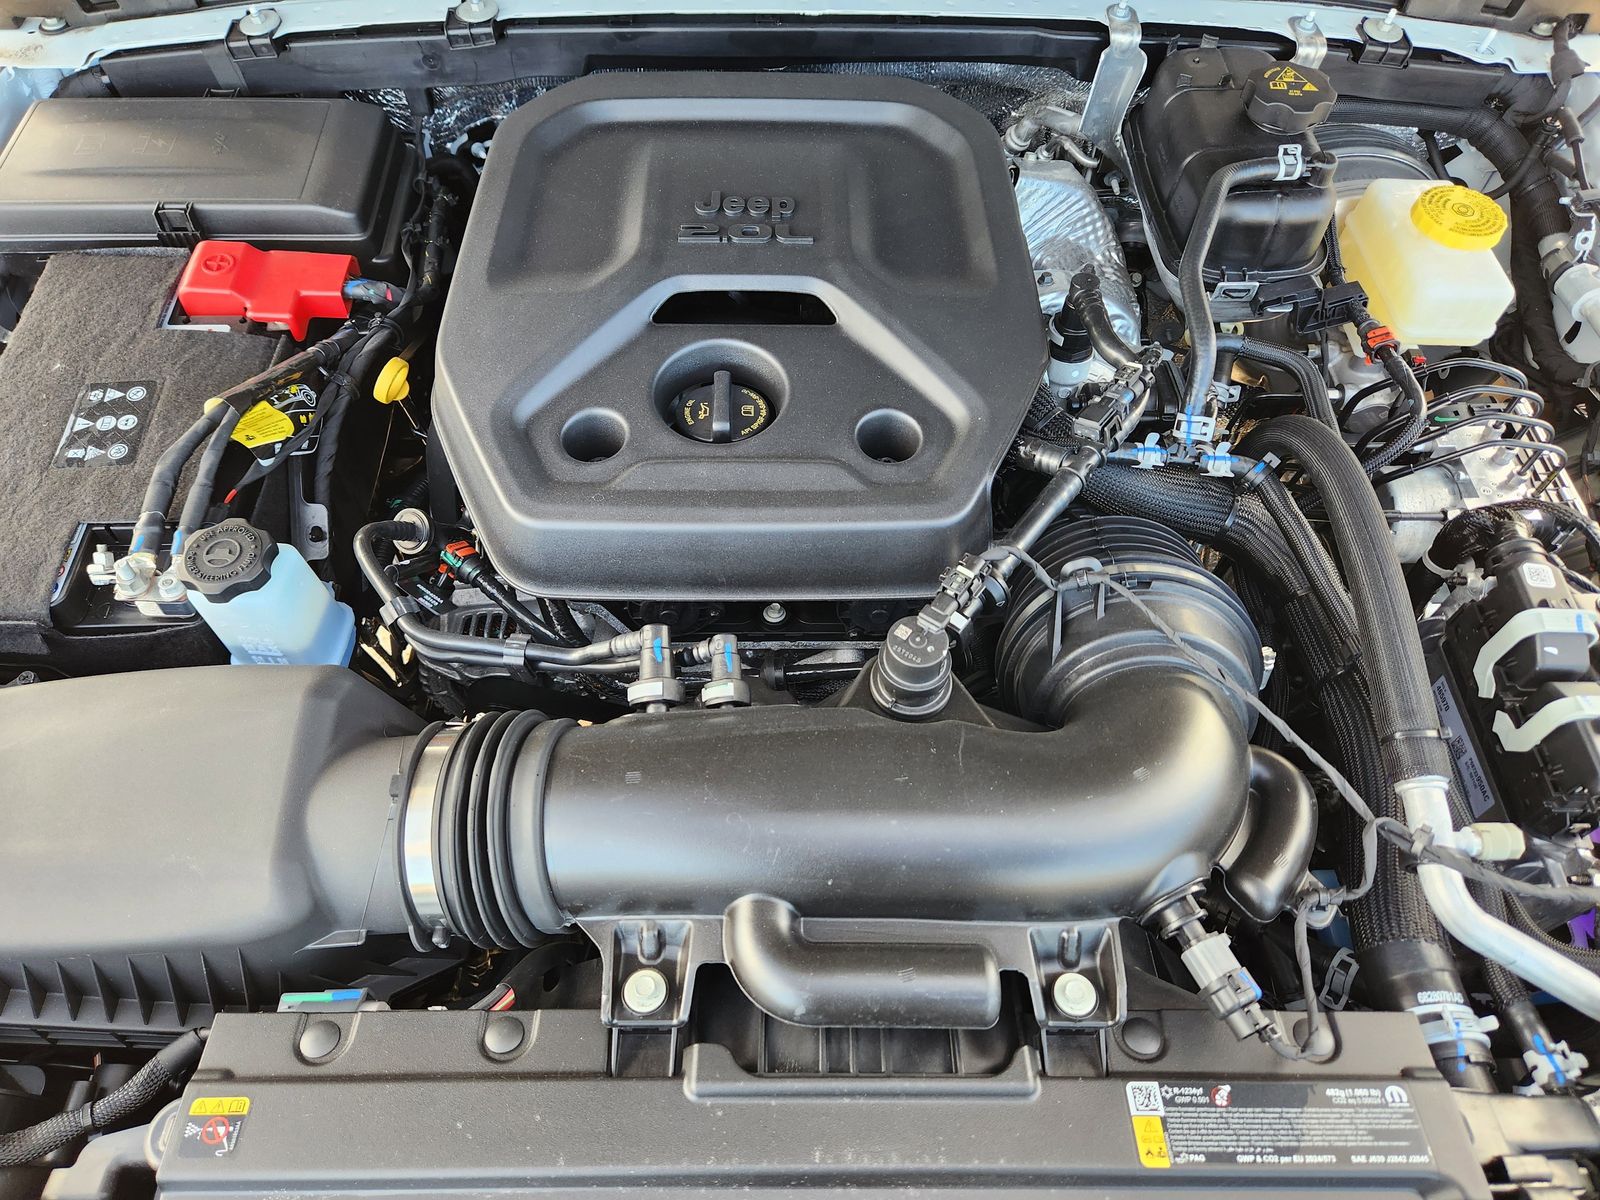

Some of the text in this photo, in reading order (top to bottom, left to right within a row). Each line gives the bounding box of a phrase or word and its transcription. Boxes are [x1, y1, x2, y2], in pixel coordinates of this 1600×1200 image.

[694, 190, 796, 221] Jeep
[677, 223, 814, 244] 2.0L
[684, 399, 696, 426] ENGINE OIL
[741, 427, 753, 436] API
[199, 525, 256, 542] USE APPROVED
[199, 569, 239, 582] STEERING
[238, 551, 256, 573] FLUID
[1189, 1154, 1206, 1162] PAG
[1236, 1155, 1255, 1163] GWP
[1255, 1155, 1262, 1163] &
[1280, 1156, 1292, 1164] per
[1293, 1155, 1304, 1163] EU
[1351, 1155, 1367, 1164] SAE
